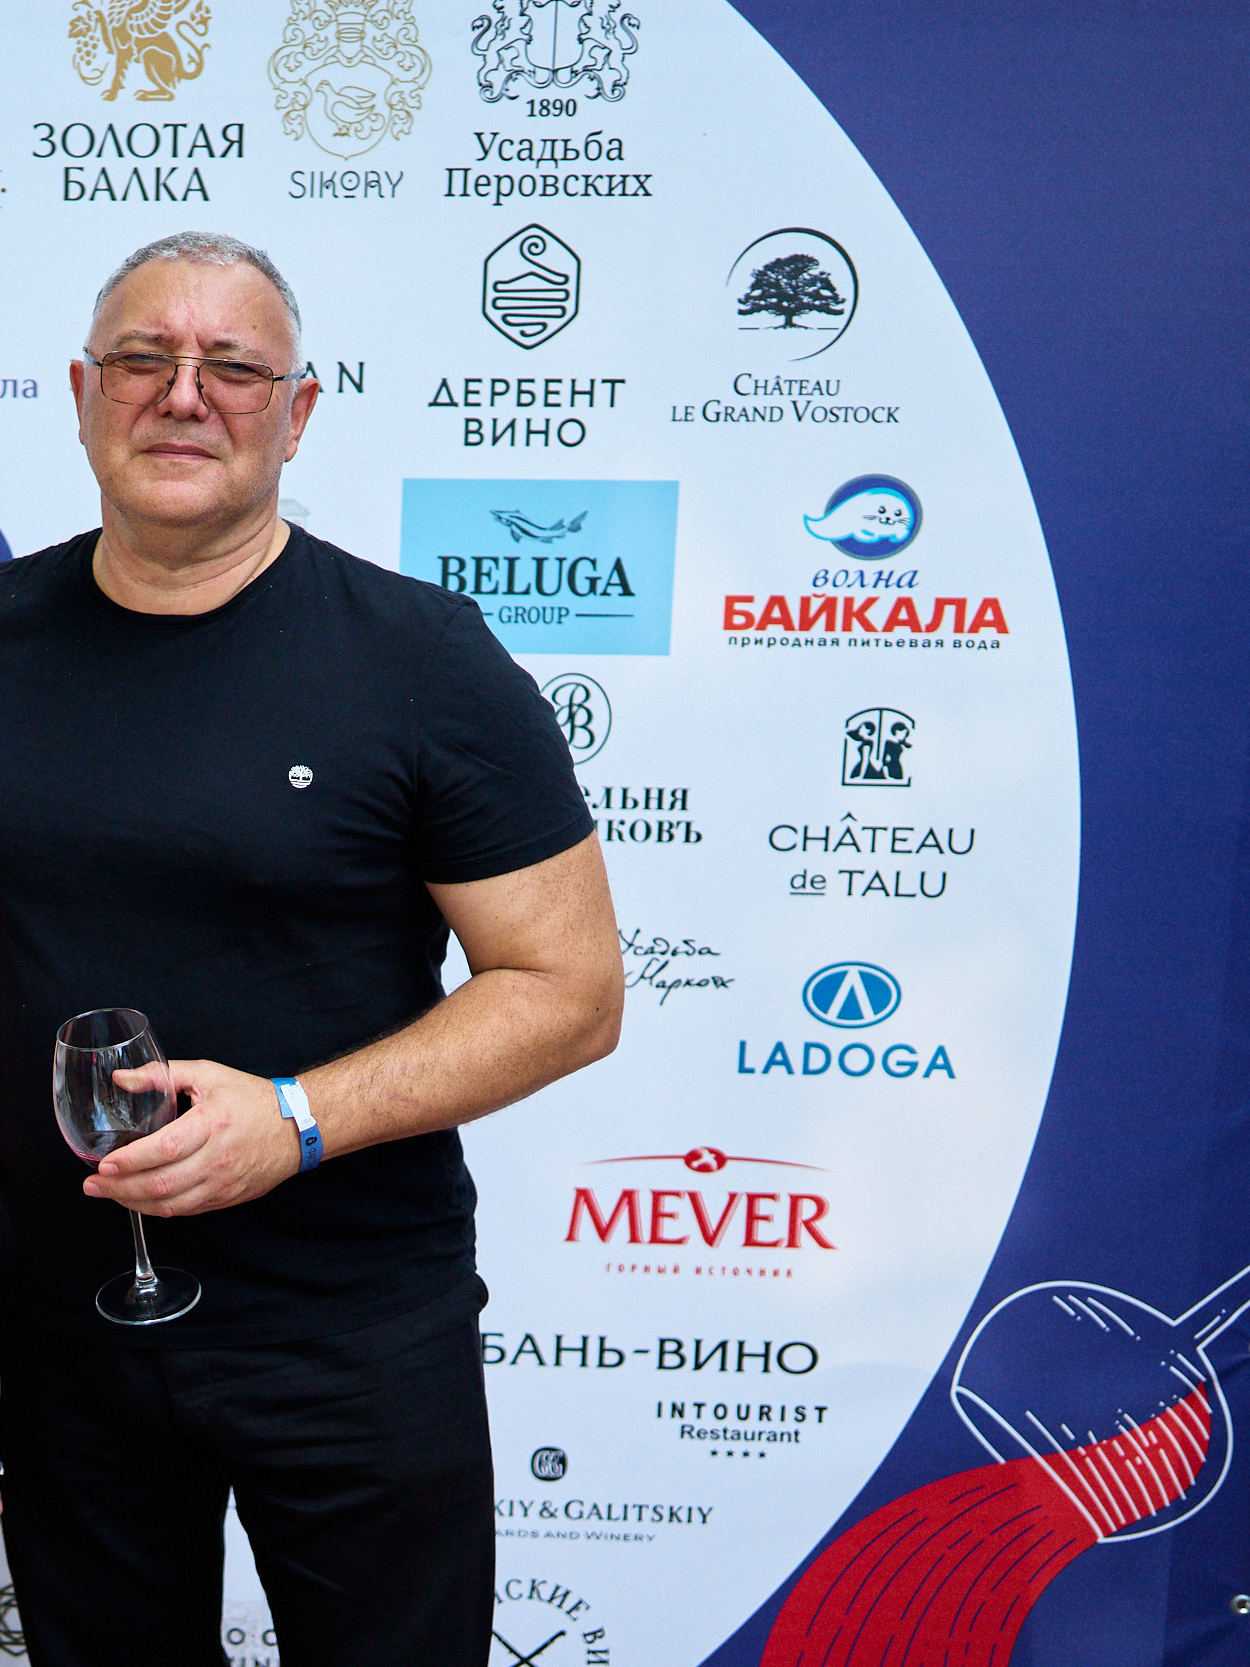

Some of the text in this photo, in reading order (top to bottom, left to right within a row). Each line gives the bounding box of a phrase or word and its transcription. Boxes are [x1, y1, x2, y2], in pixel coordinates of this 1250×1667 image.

[526, 100, 577, 117] 1890
[32, 122, 245, 159] ЗОЛОТАЯ
[473, 131, 624, 168] Усадьба
[63, 166, 209, 202] БАЛКА
[288, 170, 403, 199] SIKORY
[444, 167, 652, 206] Перовских
[428, 378, 625, 408] ДЕРБЕНТ
[463, 419, 586, 447] ВИНО
[436, 555, 637, 598] BELUGA
[812, 568, 919, 590] волна
[498, 606, 570, 625] GROUP
[723, 594, 1009, 635] БАЙКАЛА
[728, 635, 1001, 650] природная питьевая вода
[768, 811, 976, 855] CHÂTEAU
[789, 869, 947, 898] de TALU
[618, 928, 720, 956] Усадьба
[738, 1040, 956, 1079] LADOGA
[564, 1187, 839, 1250] MEVER
[606, 1262, 794, 1279] ГОРНЫЙ ИСТОЧНИК
[481, 1332, 819, 1375] БАНЬ-ВИНО
[657, 1402, 828, 1424] INTOURIST
[679, 1424, 801, 1444] Restaurant
[544, 1531, 580, 1540] AND
[586, 1531, 656, 1543] WINERY
